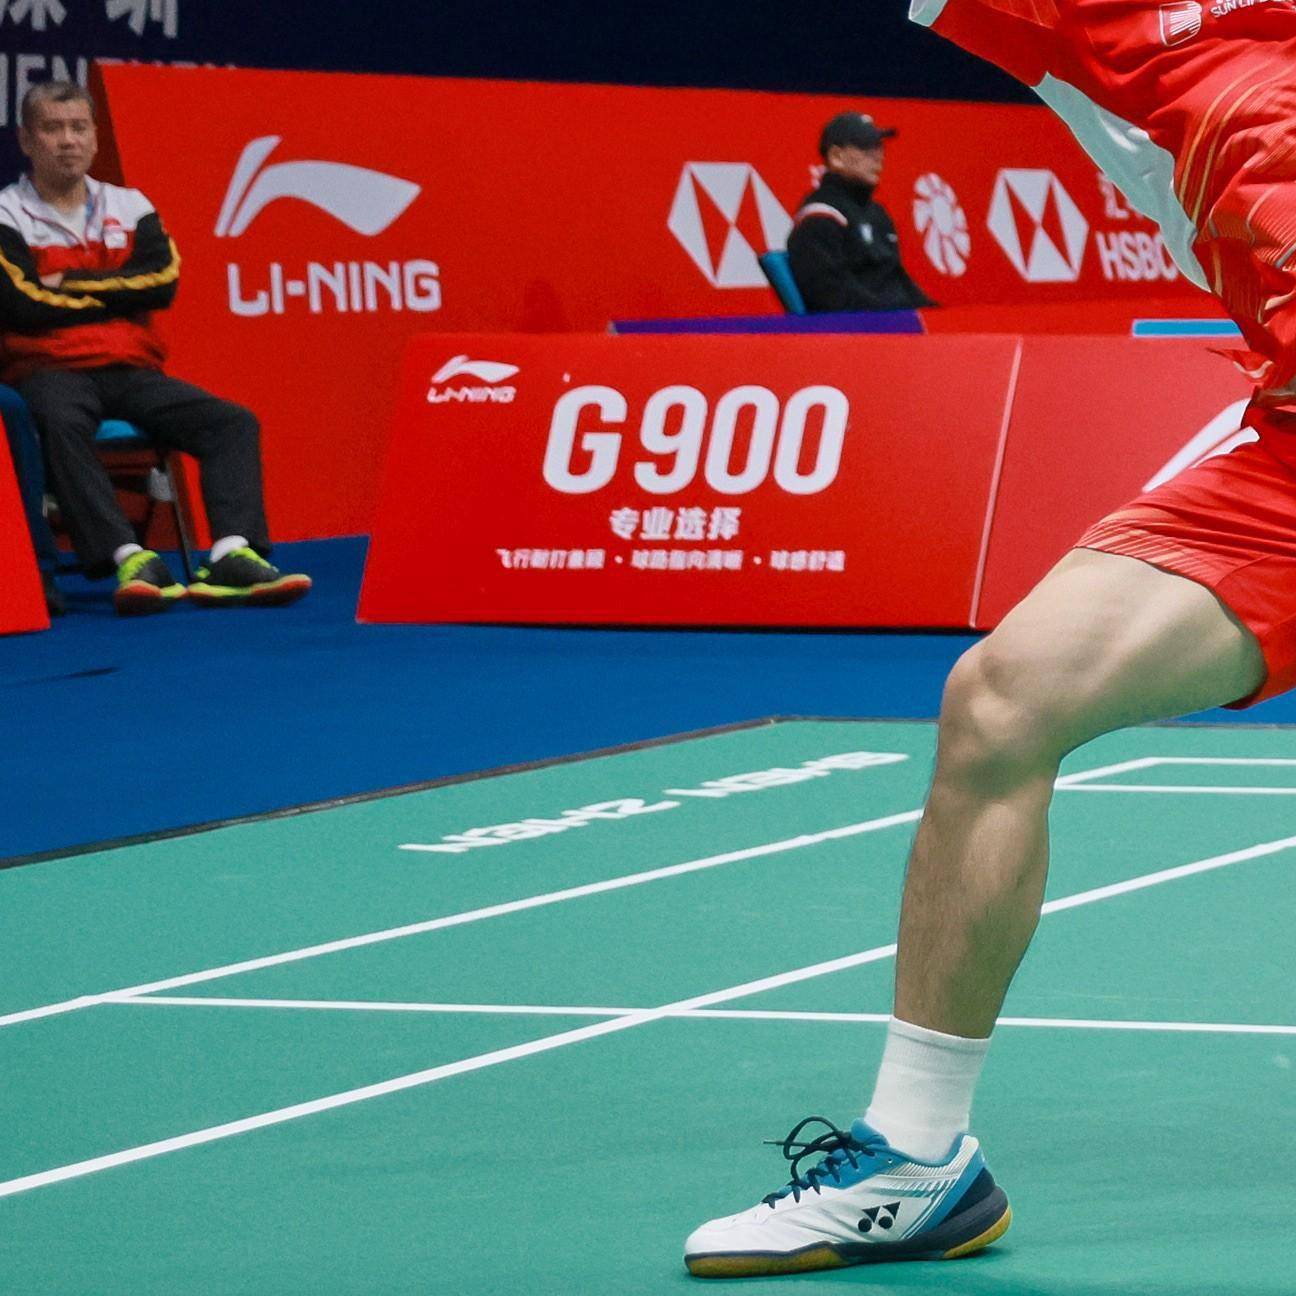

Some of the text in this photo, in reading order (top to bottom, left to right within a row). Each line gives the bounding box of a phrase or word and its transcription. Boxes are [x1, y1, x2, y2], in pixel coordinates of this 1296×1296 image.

[227, 260, 442, 316] LI-NING
[542, 384, 850, 496] G900
[609, 506, 743, 541] 专业选择
